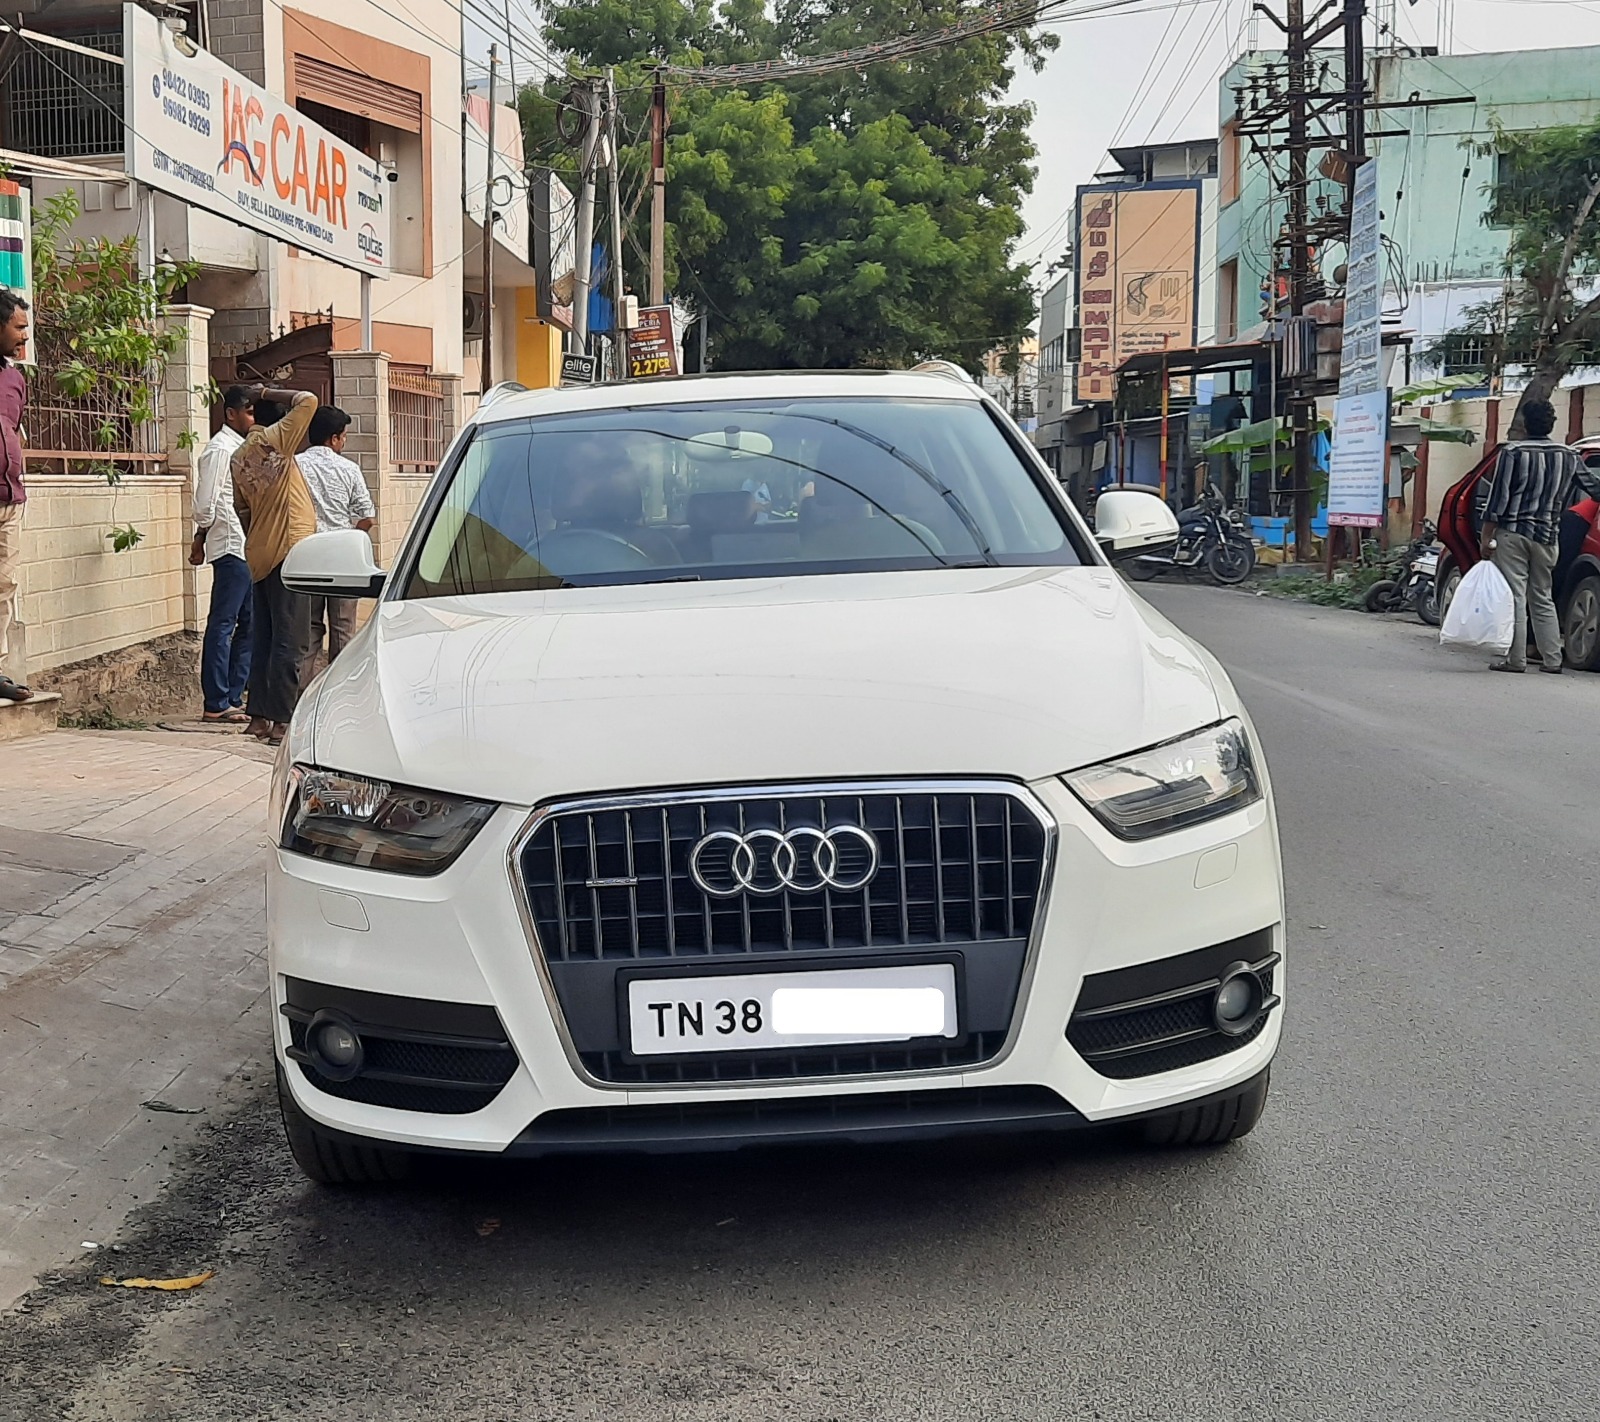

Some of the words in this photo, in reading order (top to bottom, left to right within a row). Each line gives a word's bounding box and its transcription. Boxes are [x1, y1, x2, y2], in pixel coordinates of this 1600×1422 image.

[162, 68, 187, 98] 98422
[188, 82, 210, 111] 03953
[162, 96, 187, 125] 96982
[188, 110, 211, 137] 99299
[271, 113, 348, 230] CAAR
[237, 190, 250, 210] BUY,
[251, 196, 263, 214] SELL
[268, 205, 295, 227] EXCHANGE
[295, 216, 321, 238] PRE-OWNED
[1083, 289, 1112, 304] SRI
[565, 359, 591, 373] elite
[648, 1001, 704, 1038] TN
[715, 1000, 763, 1035] 38
